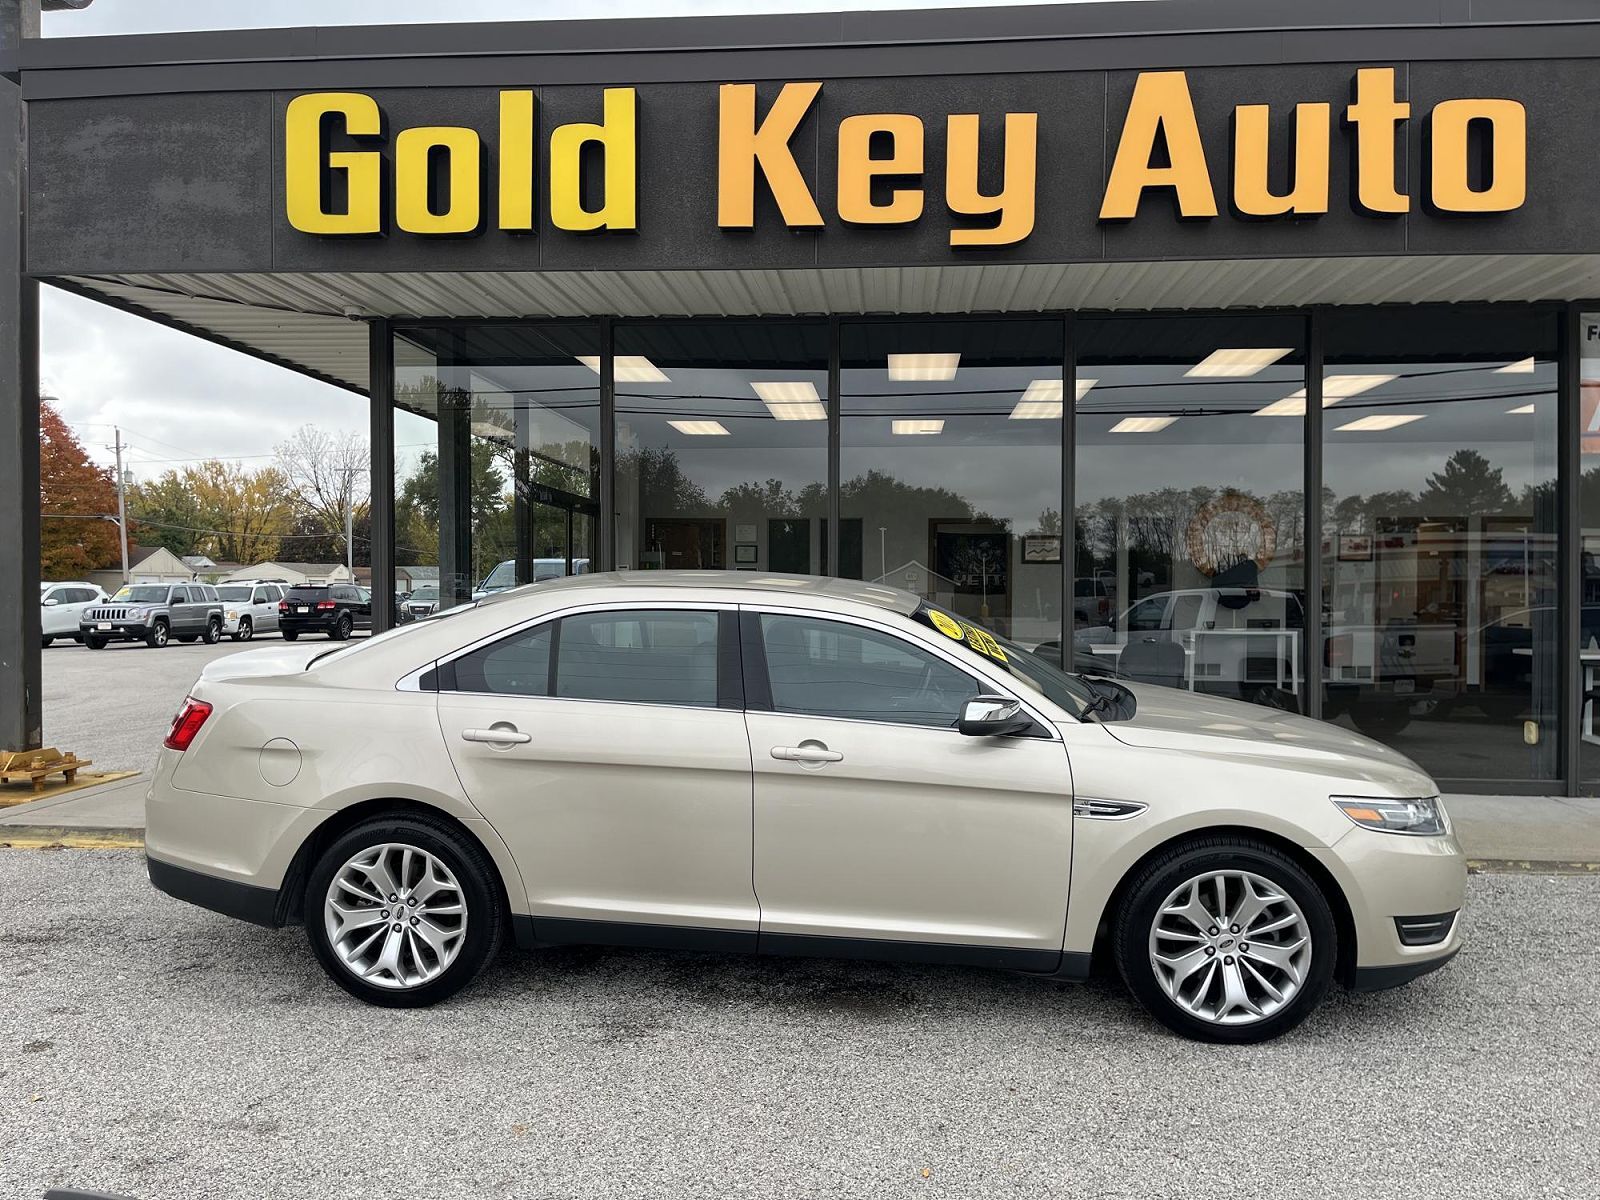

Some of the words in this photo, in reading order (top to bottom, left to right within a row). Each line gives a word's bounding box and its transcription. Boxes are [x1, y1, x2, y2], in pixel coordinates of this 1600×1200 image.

[286, 87, 638, 235] Gold
[717, 81, 1038, 246] Key
[1099, 67, 1527, 219] Auto
